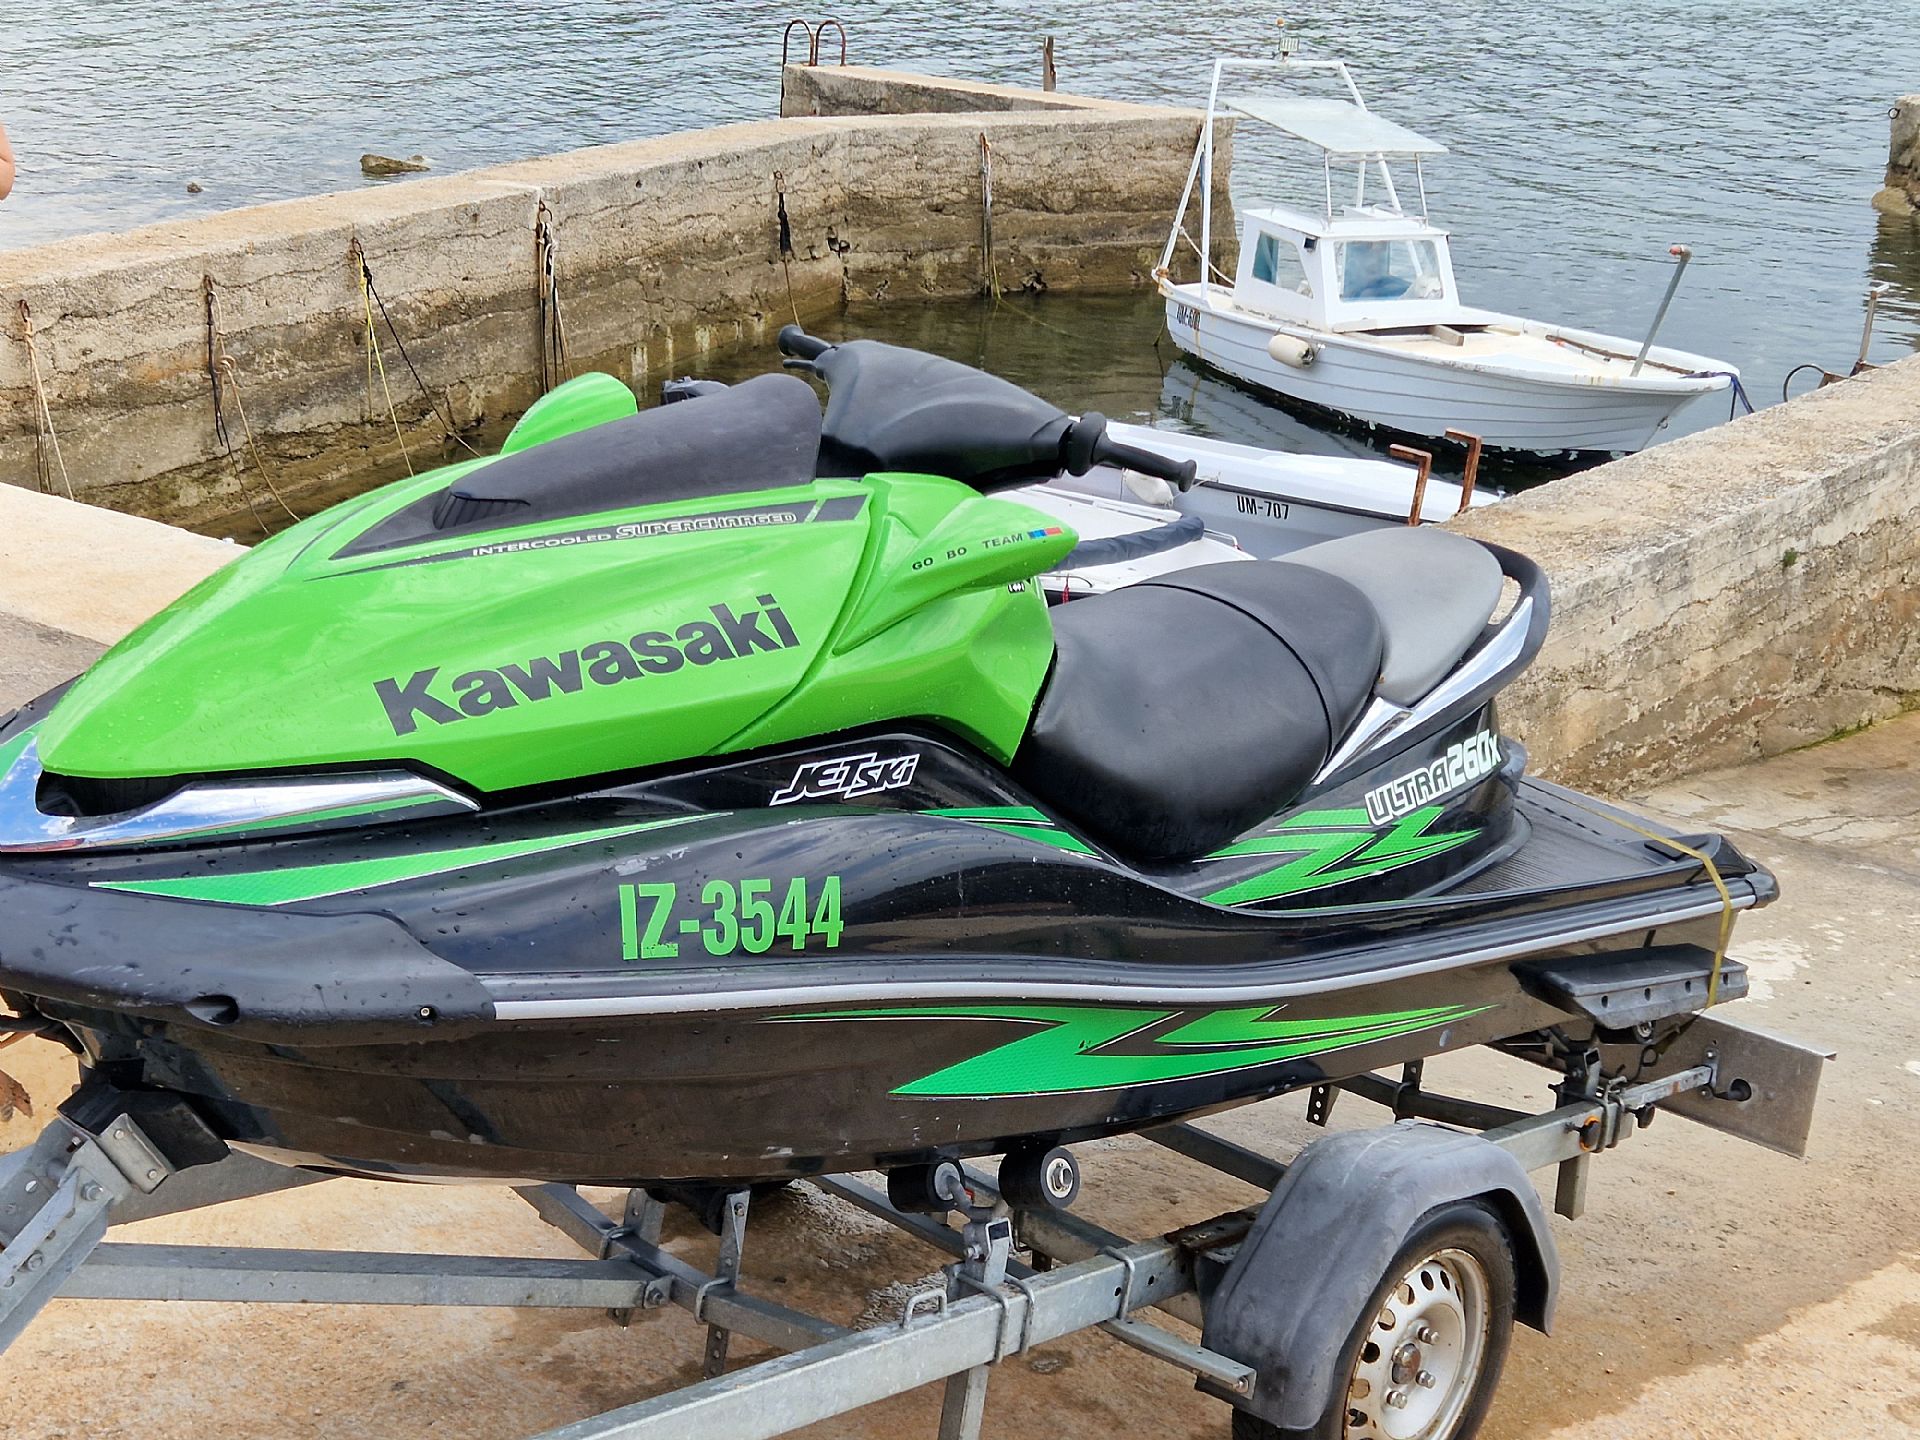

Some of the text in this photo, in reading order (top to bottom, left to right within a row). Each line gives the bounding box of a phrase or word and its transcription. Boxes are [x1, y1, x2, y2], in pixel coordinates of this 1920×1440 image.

[1237, 495, 1289, 520] UM-707
[472, 512, 797, 556] INTERCOOLED SUPERCHARGED
[912, 533, 1023, 570] GO BO TEAM
[373, 593, 801, 736] Kawasaki
[619, 876, 844, 960] IZ-3544
